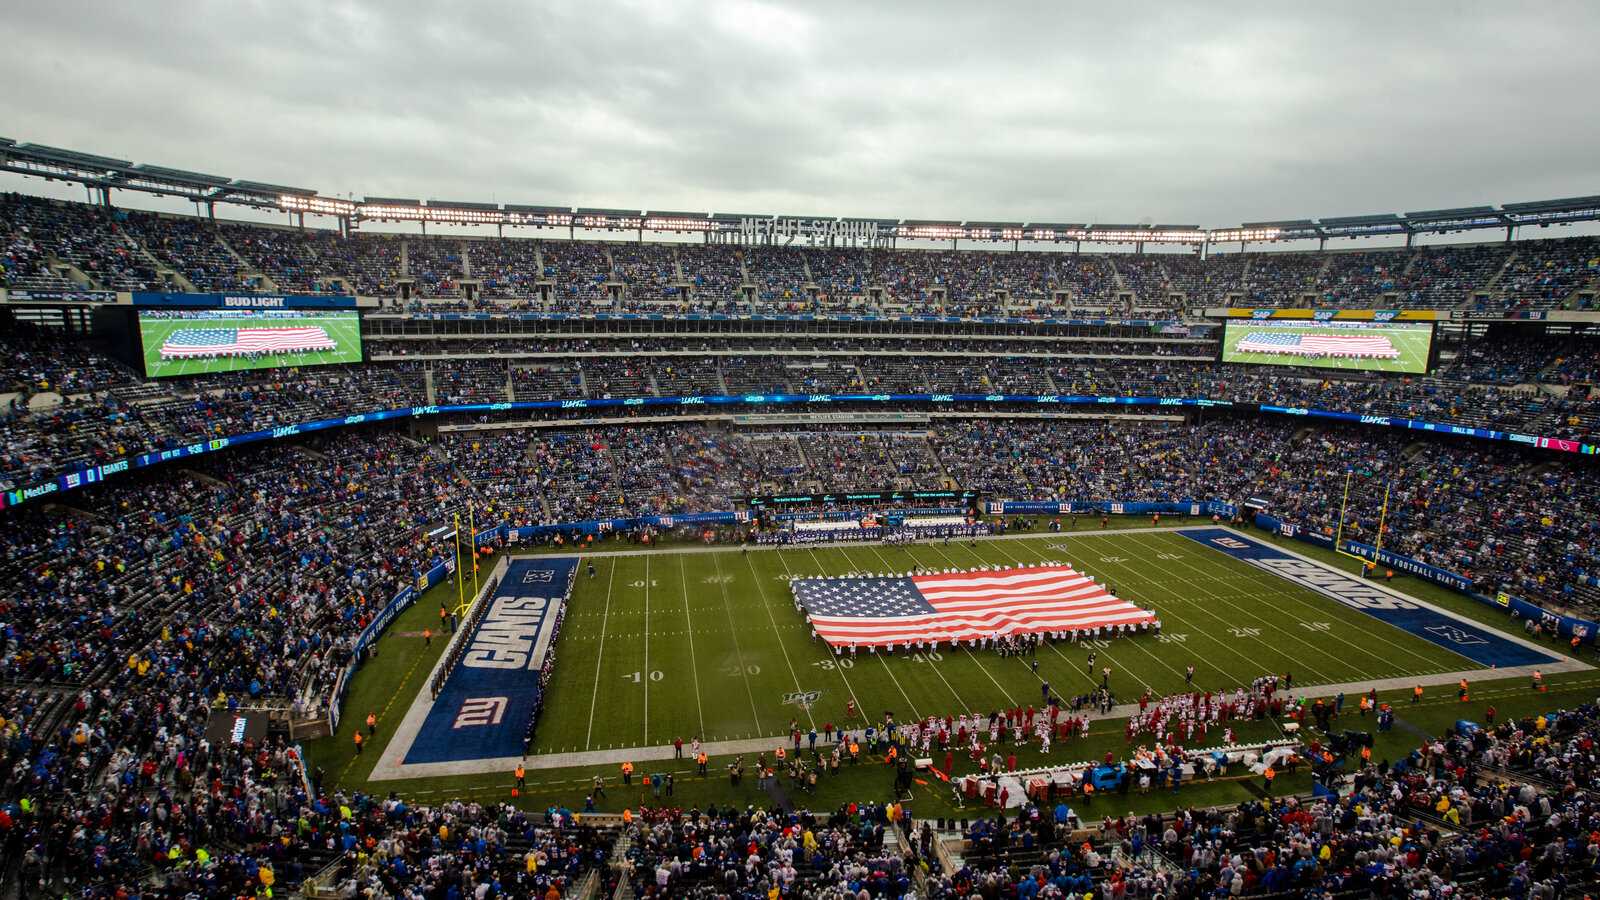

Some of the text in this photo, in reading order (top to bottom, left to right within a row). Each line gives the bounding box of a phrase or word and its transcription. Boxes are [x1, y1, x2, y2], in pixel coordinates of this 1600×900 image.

[741, 218, 877, 240] METLIFE STADIUM
[225, 297, 284, 306] BUD LIGHT
[1314, 312, 1332, 320] SAP
[1374, 312, 1394, 321] SAP
[1541, 438, 1548, 448] 0
[103, 460, 128, 475] GIANTS
[87, 469, 95, 482] 0
[24, 482, 58, 499] MetLife
[1350, 545, 1367, 556] NEW
[1371, 551, 1391, 563] YORK
[1394, 559, 1432, 578] FOOTBALL
[1259, 558, 1420, 610] GIANTS
[1499, 595, 1508, 604] 25
[376, 608, 395, 633] FOOTBALL
[396, 592, 412, 610] GIANTS
[463, 596, 546, 670] GIANTS
[1153, 633, 1186, 643] 30
[1227, 627, 1260, 638] 20
[1080, 640, 1110, 649] 40
[821, 658, 854, 670] 30
[912, 653, 943, 663] 40
[632, 670, 664, 683] 10
[728, 665, 760, 676] 20
[452, 696, 508, 729] ny
[231, 717, 247, 744] verizon
